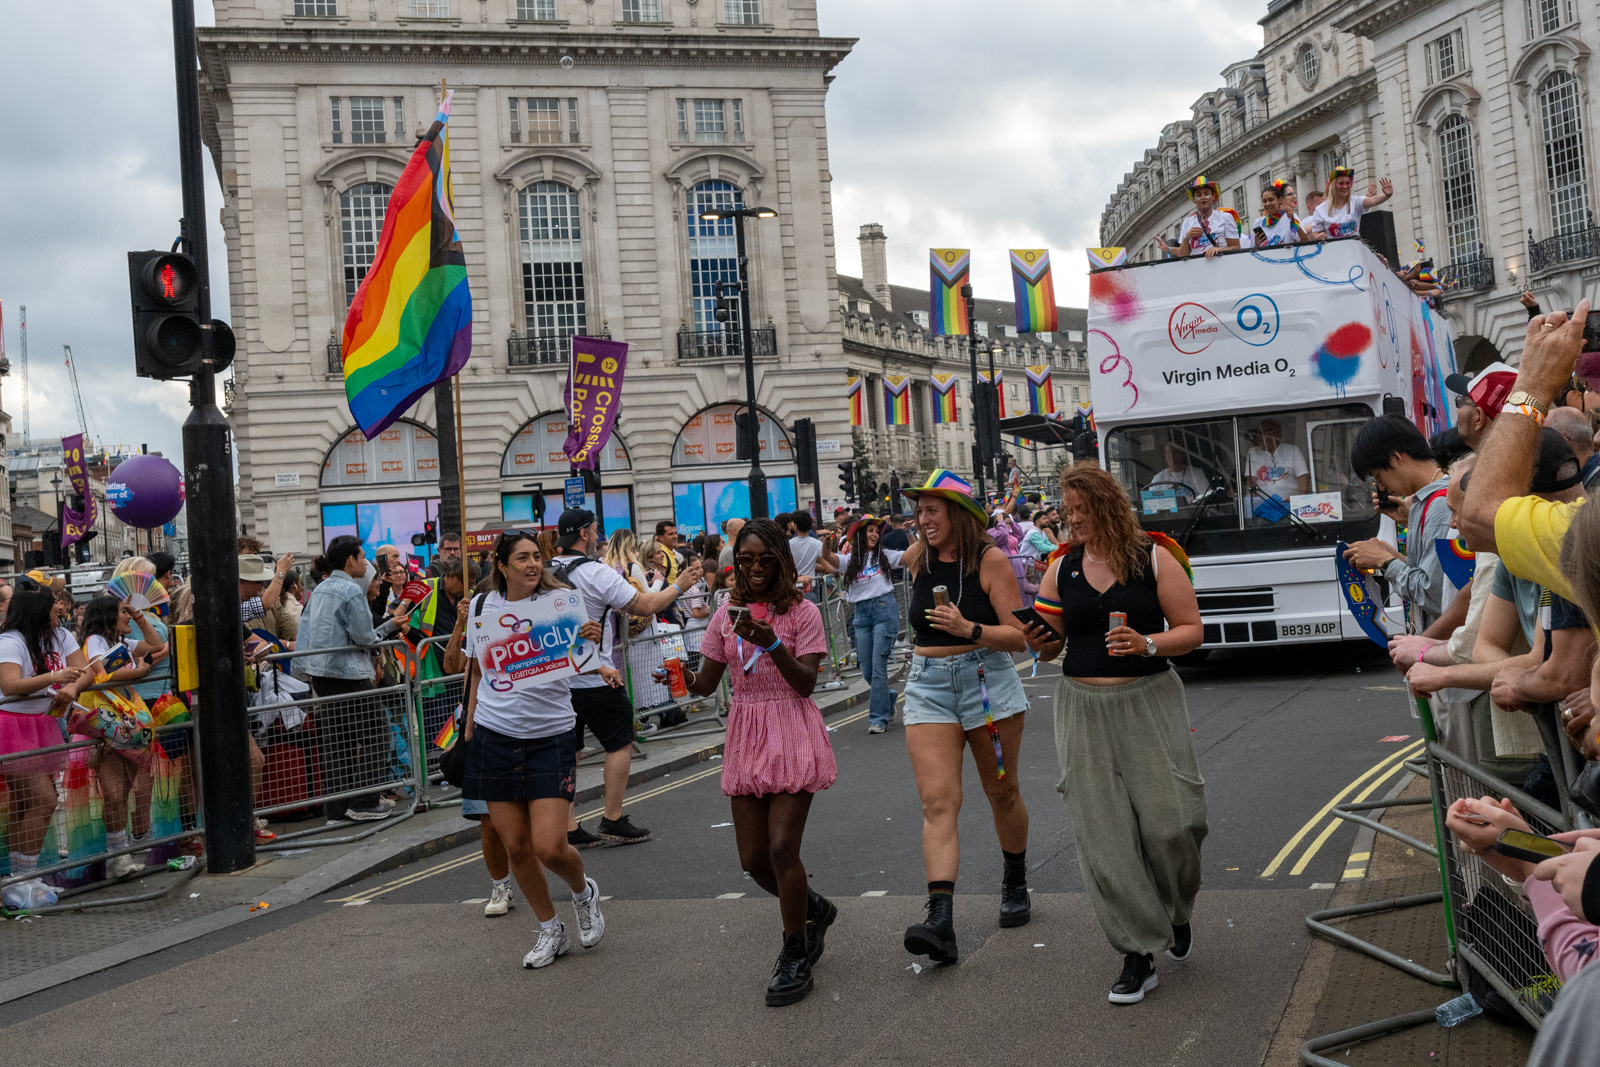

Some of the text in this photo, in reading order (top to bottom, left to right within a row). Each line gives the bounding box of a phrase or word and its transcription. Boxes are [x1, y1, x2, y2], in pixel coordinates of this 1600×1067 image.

[1175, 312, 1205, 340] Virgin
[1195, 325, 1218, 335] media
[605, 361, 614, 370] 12
[1162, 358, 1296, 386] Virgin Media O2
[570, 388, 588, 433] Point
[571, 391, 612, 463] Crossing
[476, 534, 492, 542] BUY
[1282, 622, 1336, 636] B839 AOP
[476, 635, 490, 644] I'm
[507, 655, 551, 673] championing
[511, 660, 567, 681] LGBTQIA+ voices
